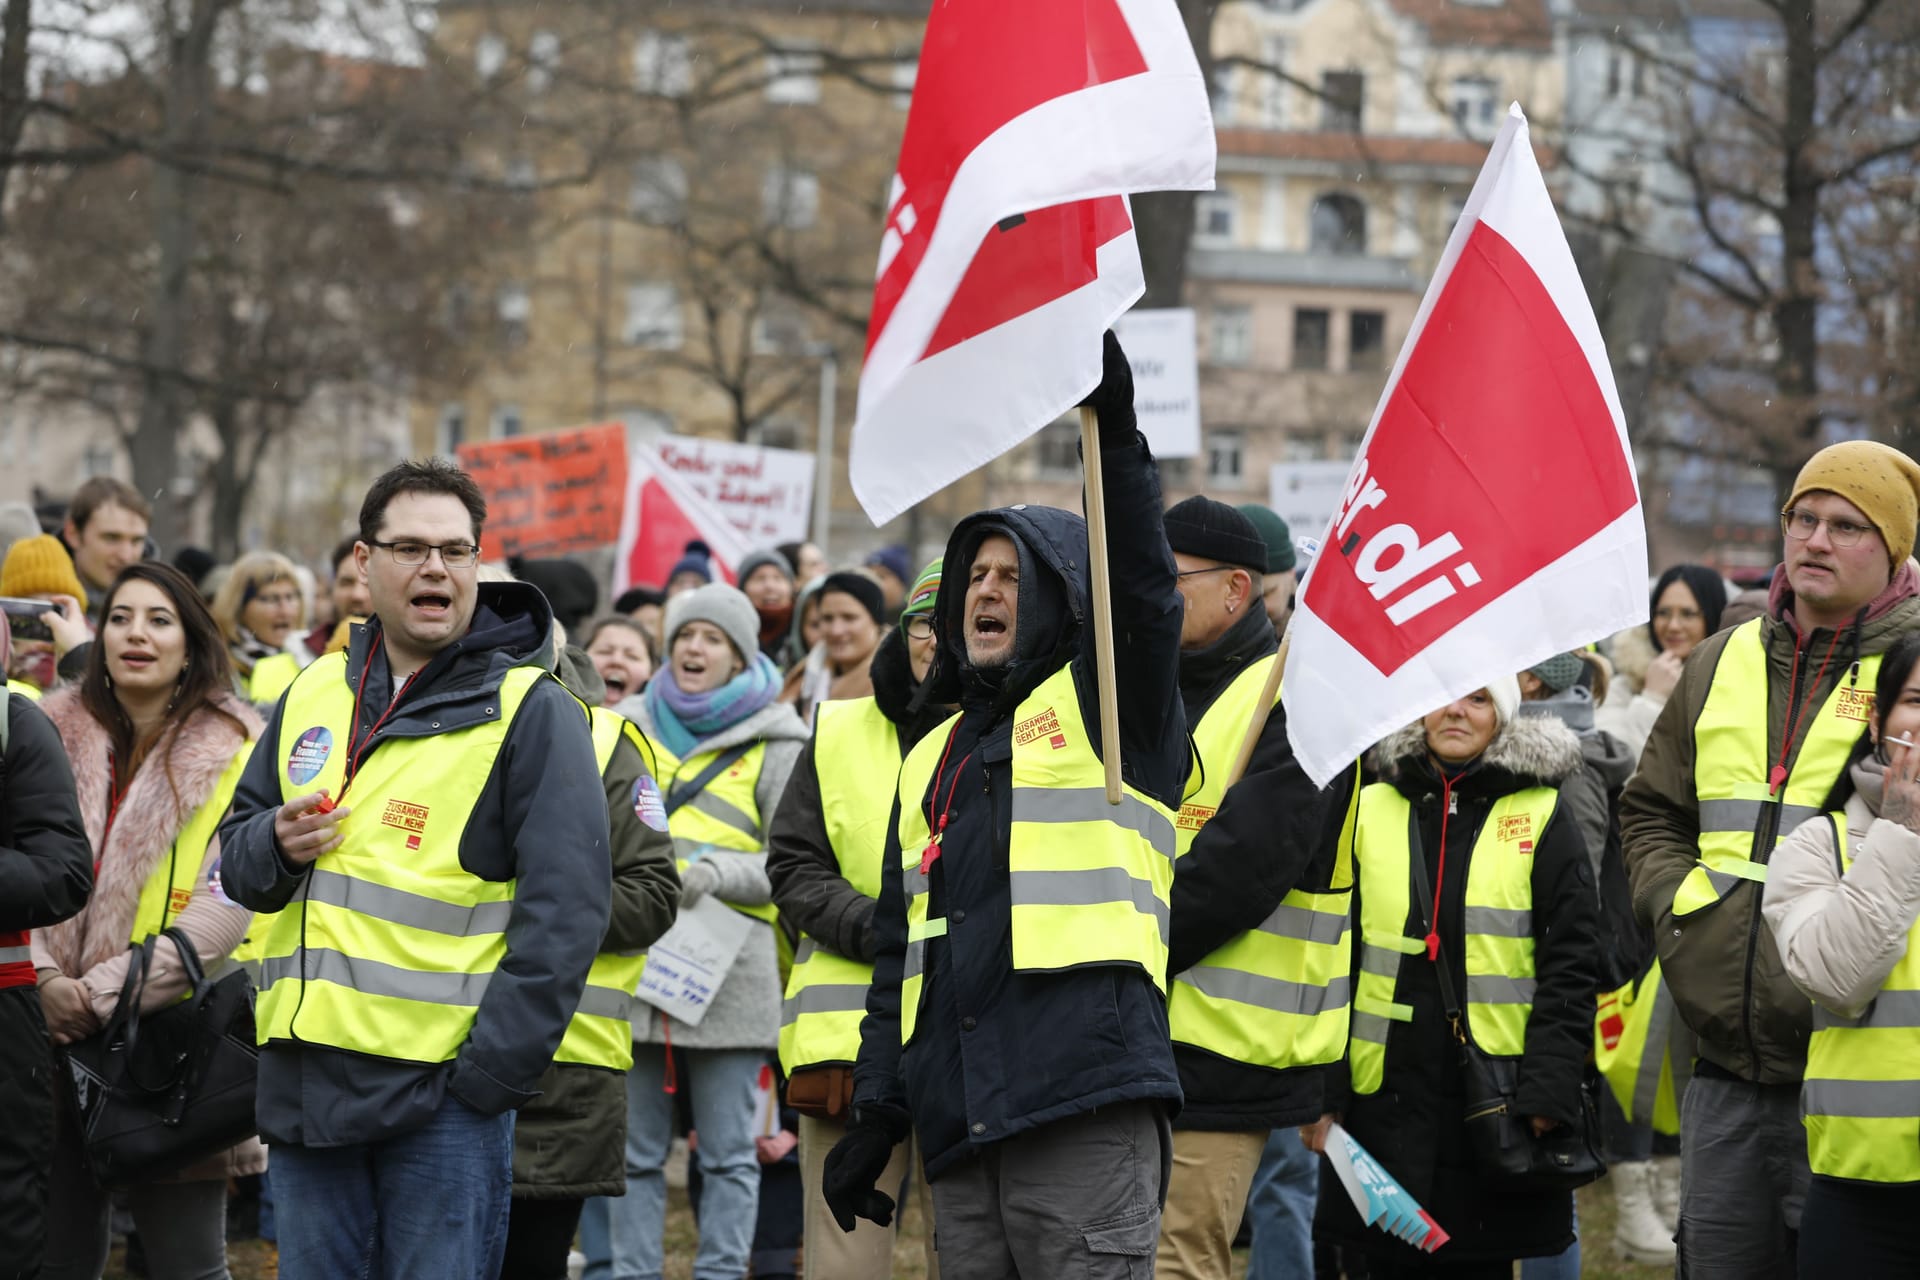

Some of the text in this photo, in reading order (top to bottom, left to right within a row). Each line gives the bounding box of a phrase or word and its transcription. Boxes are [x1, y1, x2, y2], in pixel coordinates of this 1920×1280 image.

[1335, 457, 1483, 627] er.di
[1836, 703, 1863, 717] GEHT
[1015, 709, 1057, 735] ZUSAMMEN
[1016, 718, 1060, 744] GEHT MEHR
[382, 811, 426, 831] GEHT MEHR
[385, 801, 429, 820] ZUSAMMEN
